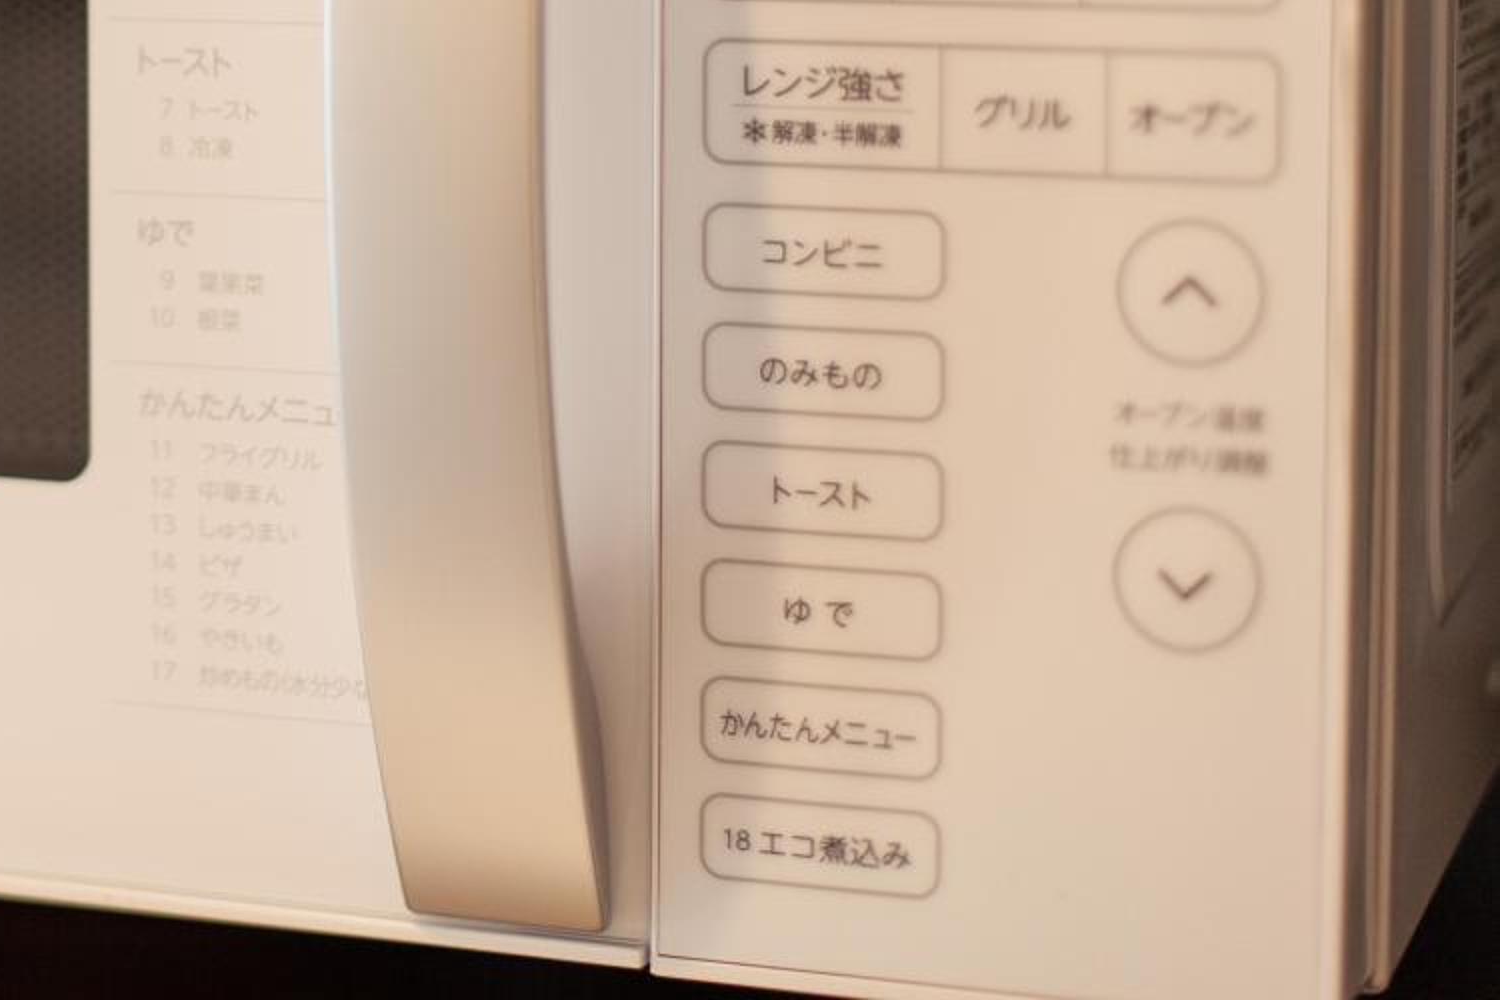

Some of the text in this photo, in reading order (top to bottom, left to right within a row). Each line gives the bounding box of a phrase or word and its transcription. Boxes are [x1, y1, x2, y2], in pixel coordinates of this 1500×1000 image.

[137, 45, 233, 79] トースト
[742, 64, 904, 102] レンジ強さ
[976, 95, 1071, 131] グリル
[137, 219, 194, 247] ゆで
[762, 238, 884, 269] コンビニ
[759, 358, 882, 390] のみもの
[771, 477, 871, 510] トースト
[783, 597, 854, 628] ゆで
[719, 709, 917, 751] かんたんメニュー
[722, 828, 912, 871] 18 エコ煮込み
